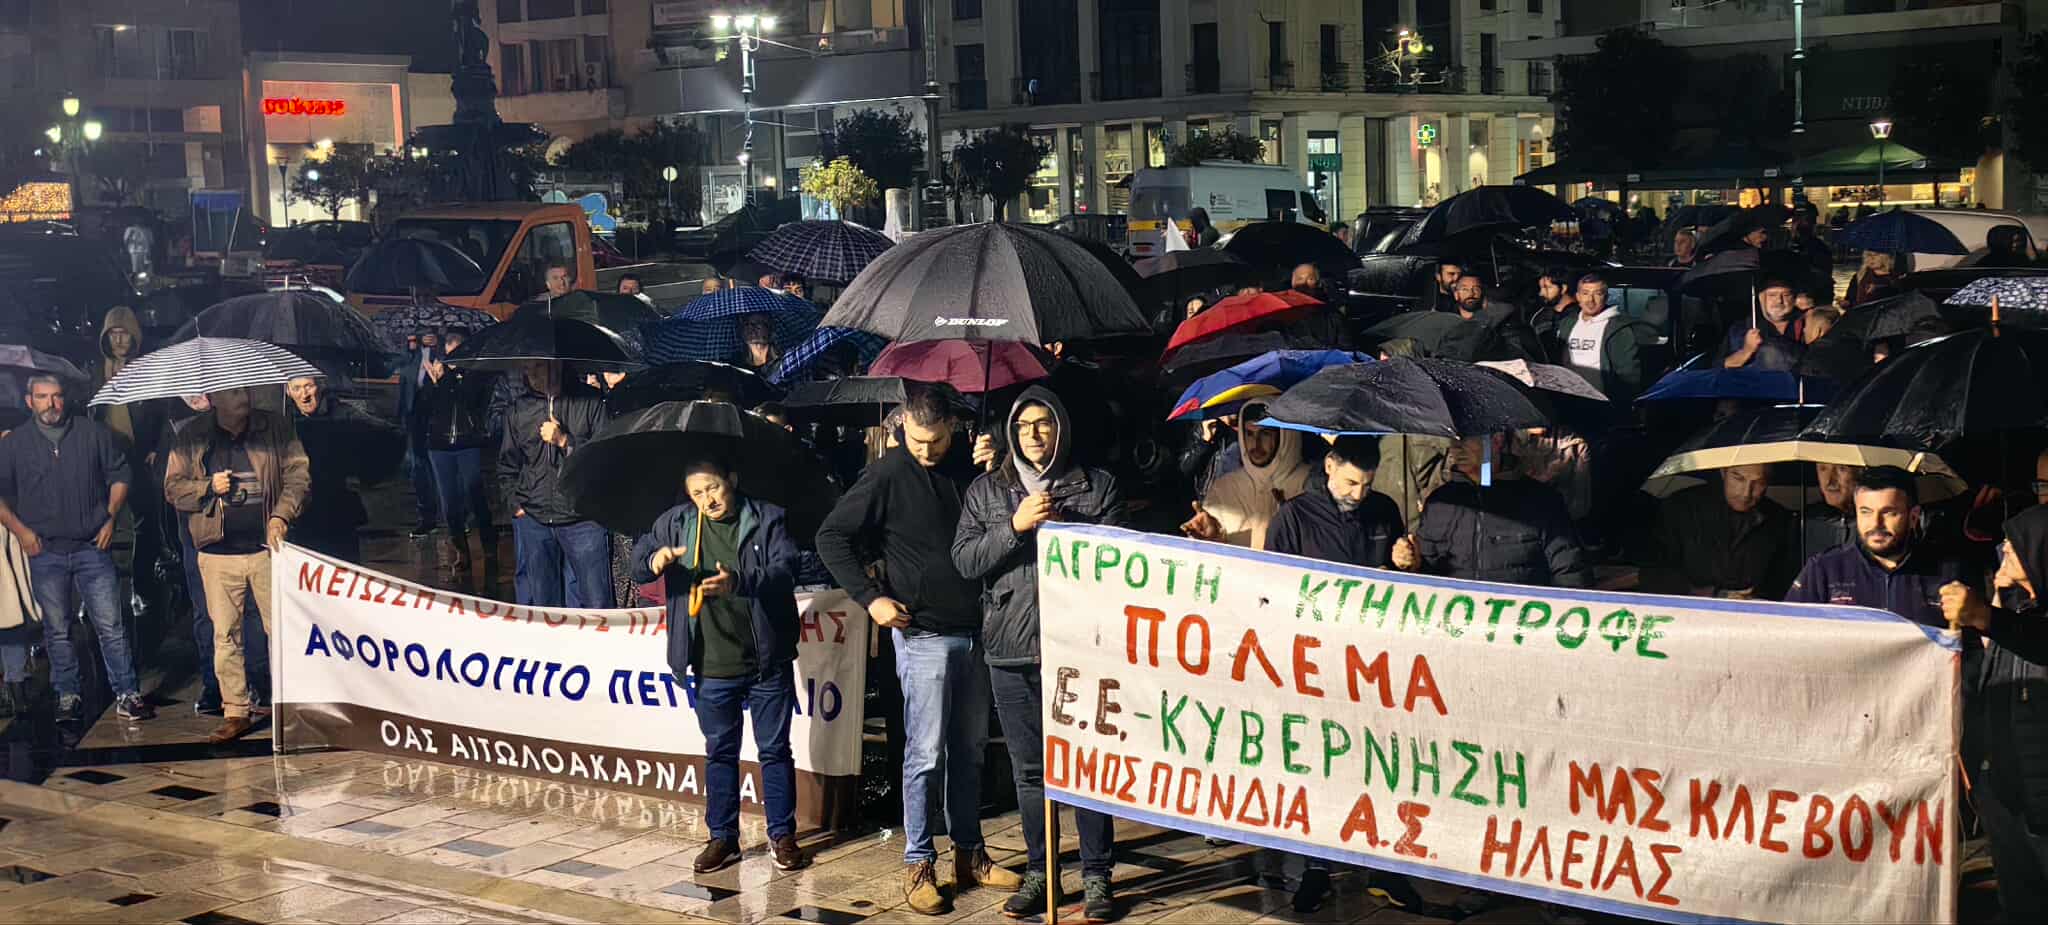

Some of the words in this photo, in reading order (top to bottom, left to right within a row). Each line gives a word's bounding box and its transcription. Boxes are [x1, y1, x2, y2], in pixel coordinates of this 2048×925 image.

[947, 318, 1009, 327] DUNLOP
[1046, 536, 1222, 603] ΑΓΡΟΤΗ
[1296, 573, 1674, 659] ΚΤΗΝΟΤΡΟΦΕ
[305, 624, 591, 701] ΑΦΟΡΟΛΟΓΗΤΟ
[609, 669, 843, 722] ΠΕΤΡΙΟ
[1124, 604, 1448, 716] ΠΟΛΕΜΑ
[381, 719, 439, 754] ΟΑΣ
[1340, 793, 1438, 859] Α.Σ.
[1480, 815, 1682, 905] ΗΛΕΙΑΣ
[1568, 760, 1671, 832] ΜΑΣ
[1689, 778, 1943, 865] ΚΛΕΒΟΥΝ
